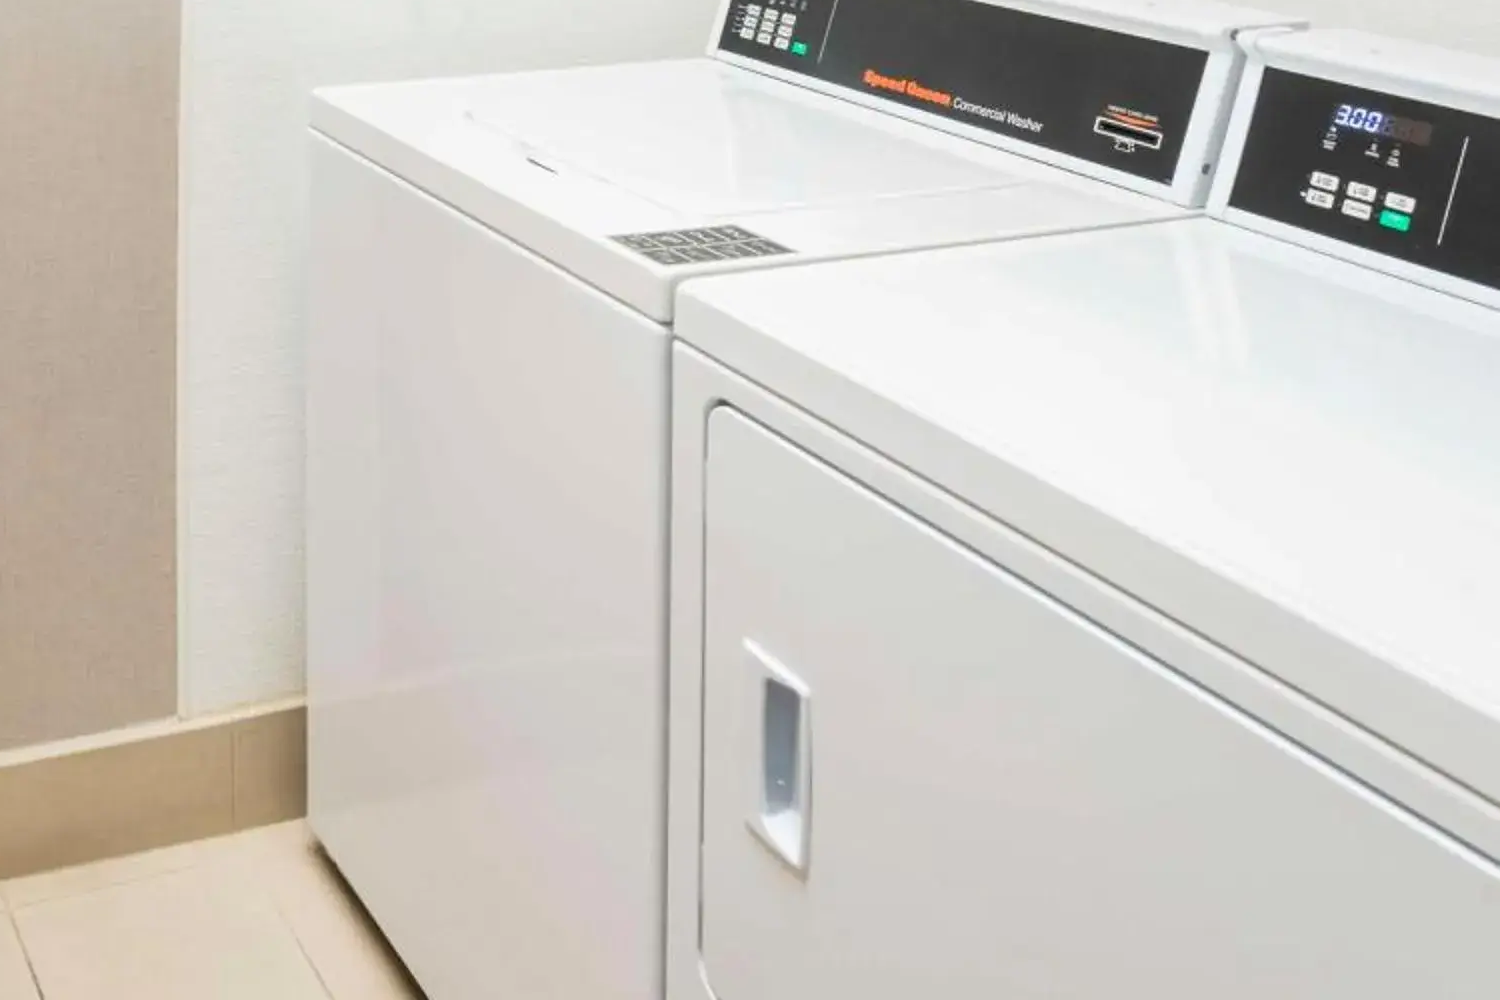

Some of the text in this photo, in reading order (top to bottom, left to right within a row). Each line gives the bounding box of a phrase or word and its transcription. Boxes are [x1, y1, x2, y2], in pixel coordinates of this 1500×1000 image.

[863, 69, 952, 108] Speed Queen
[954, 97, 1044, 133] Commercial Washer
[1335, 104, 1382, 133] 3.00
